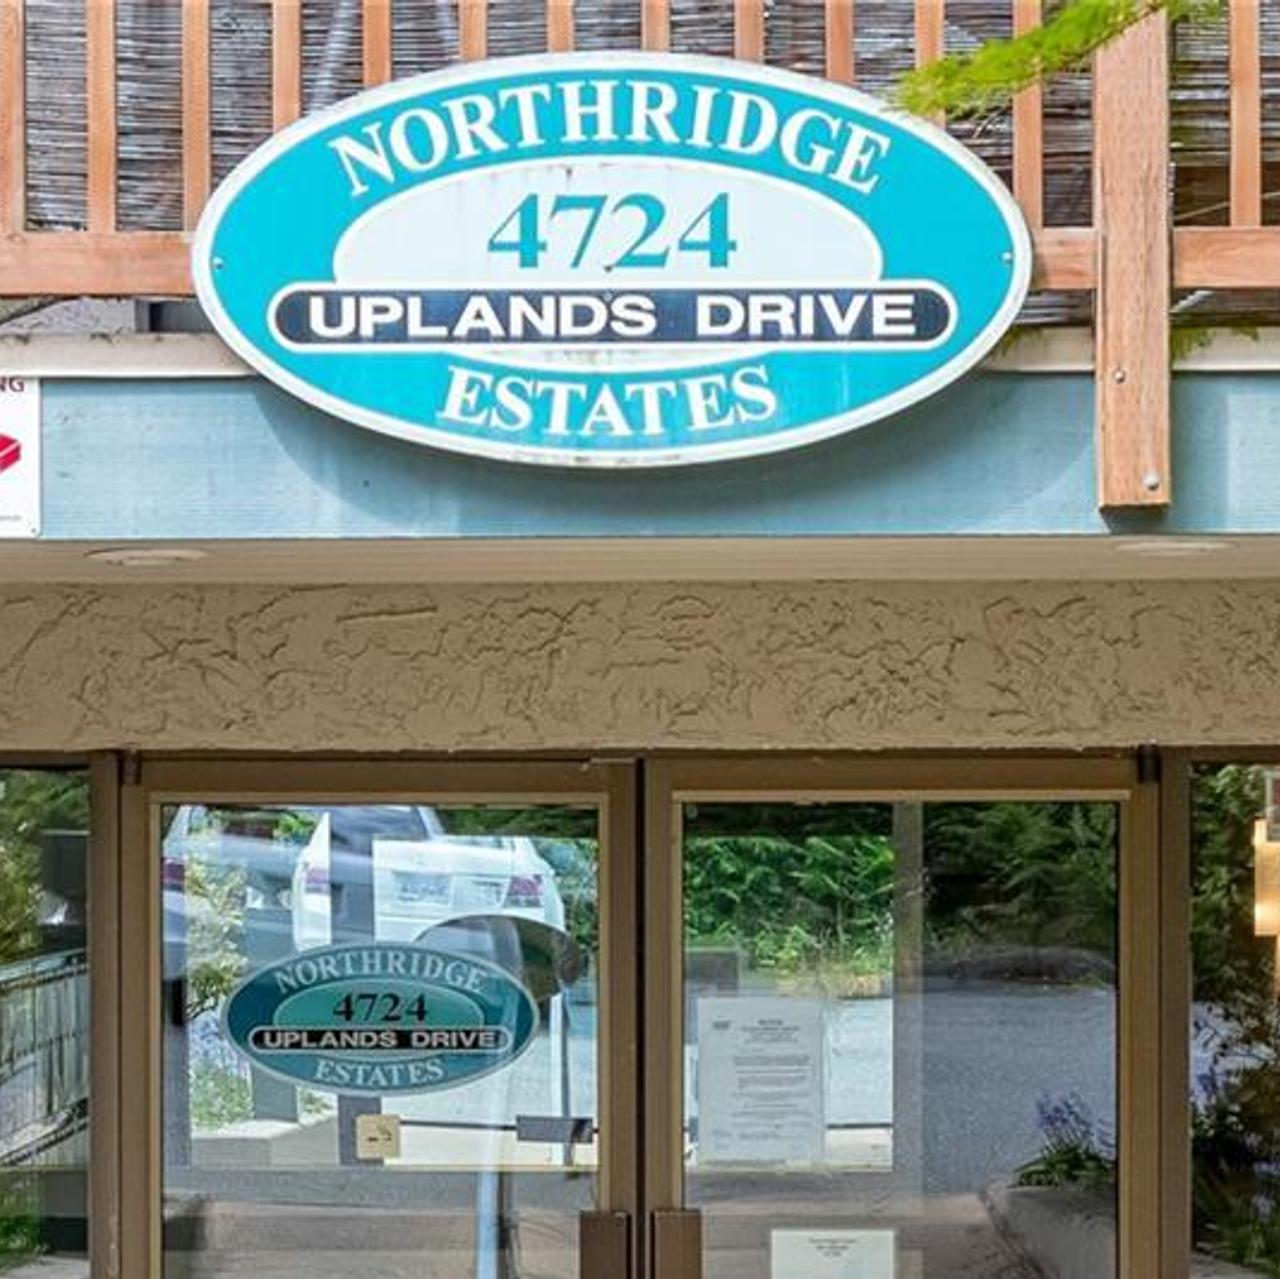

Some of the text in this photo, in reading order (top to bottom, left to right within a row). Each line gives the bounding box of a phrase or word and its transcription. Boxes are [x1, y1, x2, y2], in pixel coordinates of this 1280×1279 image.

[330, 80, 890, 194] NORTHRIDGE
[486, 191, 739, 270] 4724
[308, 292, 917, 339] UPLANDS DRIVE
[440, 366, 776, 436] ESTATES
[276, 951, 488, 995] NORTHRIDGE
[333, 993, 428, 1021] 4724
[263, 1030, 495, 1048] UPLANDS DRIVE
[318, 1060, 443, 1085] ESTATES
